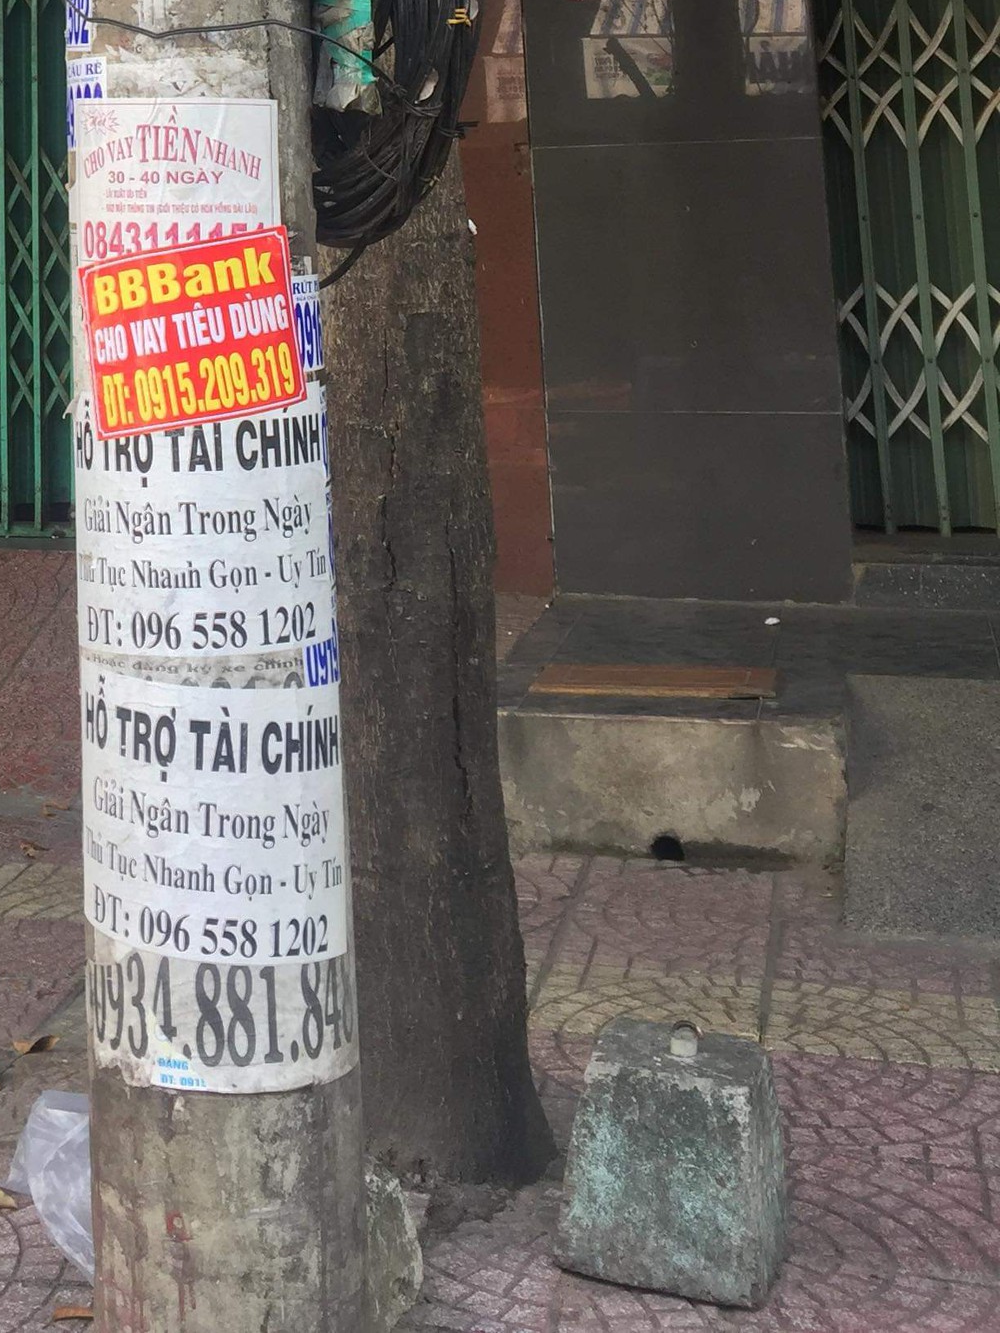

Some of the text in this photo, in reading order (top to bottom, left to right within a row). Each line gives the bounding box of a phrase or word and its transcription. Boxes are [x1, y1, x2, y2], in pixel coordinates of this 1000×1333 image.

[84, 147, 105, 178] CHO
[106, 136, 134, 163] VAY
[136, 105, 201, 165] TIỀN
[202, 136, 262, 180] NHANH
[108, 170, 125, 184] 30
[140, 170, 160, 184] 40
[166, 167, 224, 184] NGÀY
[93, 247, 276, 316] BBBank
[94, 292, 290, 364] CHO VAY TIÊU DÙNG
[102, 341, 295, 428] ĐT: 0915.209.319
[235, 407, 321, 472] CHÍNH
[84, 494, 313, 545] Giải Ngân Trong Ngày
[97, 556, 126, 593] Tục
[131, 559, 202, 590] Nhanh
[209, 559, 259, 594] Gọn
[277, 554, 302, 589] Uy
[306, 546, 327, 578] Tín
[87, 601, 316, 651] ĐT: 096 558 1202
[85, 675, 340, 783] HỖ TRỢ TÀI CHÍNH
[93, 776, 330, 849] Giải Ngân Trong Ngày
[106, 840, 138, 881] Tục
[143, 852, 216, 893] Nhanh
[223, 864, 273, 902] Gọn
[293, 864, 317, 900] Uy
[322, 856, 343, 889] Tín
[93, 883, 329, 959] ĐT: 096 558 1202
